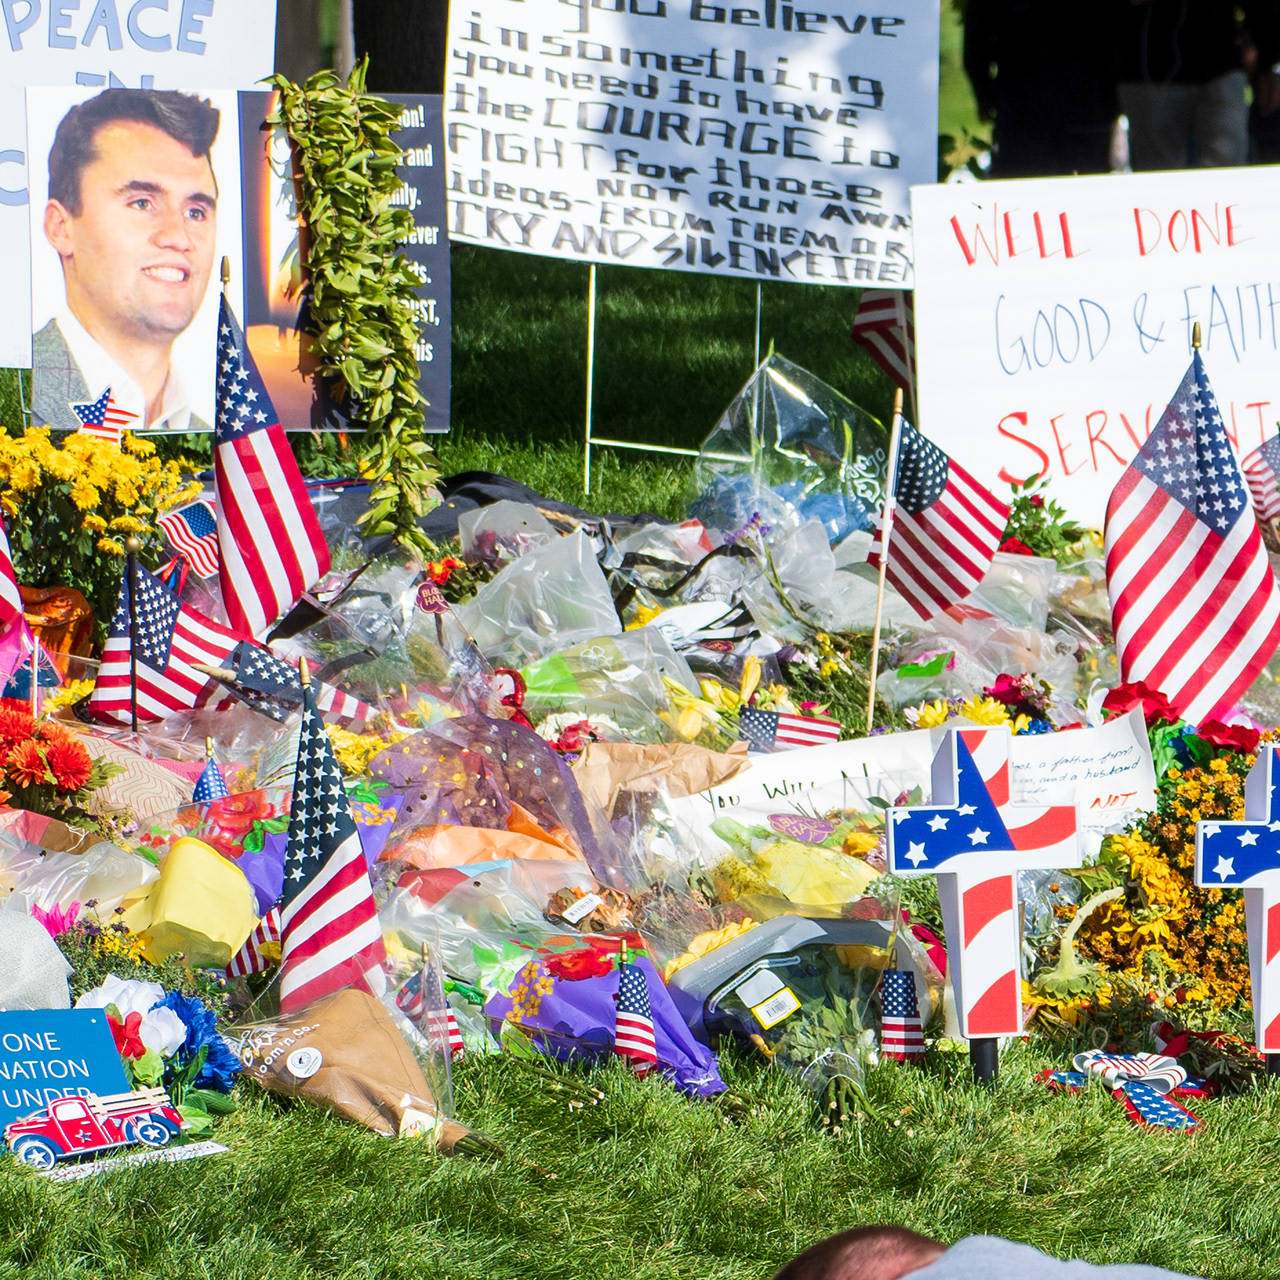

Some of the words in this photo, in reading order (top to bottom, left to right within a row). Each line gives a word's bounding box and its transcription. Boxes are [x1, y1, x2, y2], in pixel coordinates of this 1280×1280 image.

[1, 0, 214, 56] PEACE
[690, 0, 905, 37] believe
[452, 49, 534, 78] you
[545, 67, 659, 99] need
[669, 79, 721, 108] to
[735, 89, 860, 127] have
[540, 36, 885, 110] something
[407, 144, 434, 167] and
[449, 82, 534, 122] the
[545, 98, 824, 162] COURAGE
[830, 136, 900, 169] to
[448, 122, 607, 171] FIGHT
[613, 148, 700, 185] for
[709, 157, 883, 208] those
[597, 178, 690, 202] NOT
[708, 190, 799, 214] RUN
[820, 203, 912, 231] AWA
[600, 203, 715, 234] FROM
[727, 217, 840, 253] THEM
[851, 237, 911, 264] OR
[949, 201, 1092, 267] WELL
[1133, 201, 1256, 257] DONE
[448, 200, 549, 248] TRY
[551, 220, 646, 260] AND
[653, 232, 827, 281] SILENCE
[995, 294, 1111, 376] GOOD
[1133, 292, 1165, 354] &
[997, 402, 1271, 487] SERVNT
[1090, 791, 1138, 809] NOT
[2, 1032, 61, 1052] ONE
